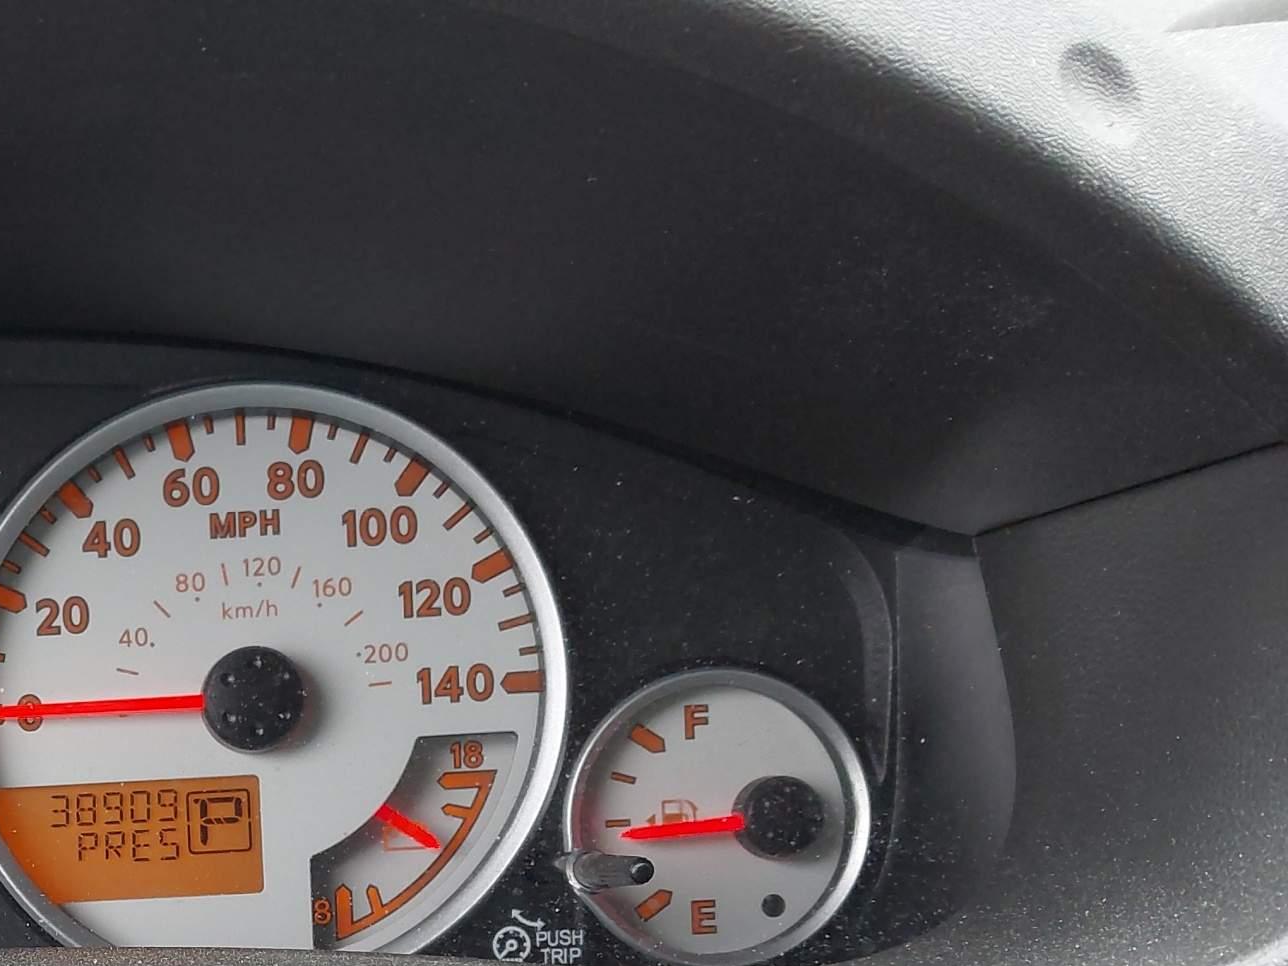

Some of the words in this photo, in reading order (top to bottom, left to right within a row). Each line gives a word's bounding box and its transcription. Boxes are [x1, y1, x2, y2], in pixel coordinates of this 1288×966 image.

[162, 468, 219, 506] 60
[267, 461, 325, 499] 80
[82, 518, 141, 558] 40
[209, 509, 281, 540] MPH
[341, 507, 419, 548] 100
[175, 573, 206, 593] 80
[242, 556, 283, 578] 120
[312, 577, 353, 597] 160
[398, 577, 472, 619] 120
[35, 597, 89, 637] 20
[221, 602, 279, 621] km/h
[118, 628, 149, 648] 40
[363, 644, 409, 664] 200
[417, 662, 495, 704] 140
[683, 704, 710, 740] F
[449, 740, 484, 769] 18
[51, 789, 178, 828] 38909
[193, 797, 244, 846] P
[77, 828, 180, 862] PRES
[313, 898, 332, 925] 8
[690, 900, 718, 935] E
[536, 930, 584, 946] PUSH
[542, 947, 583, 964] TRIP
